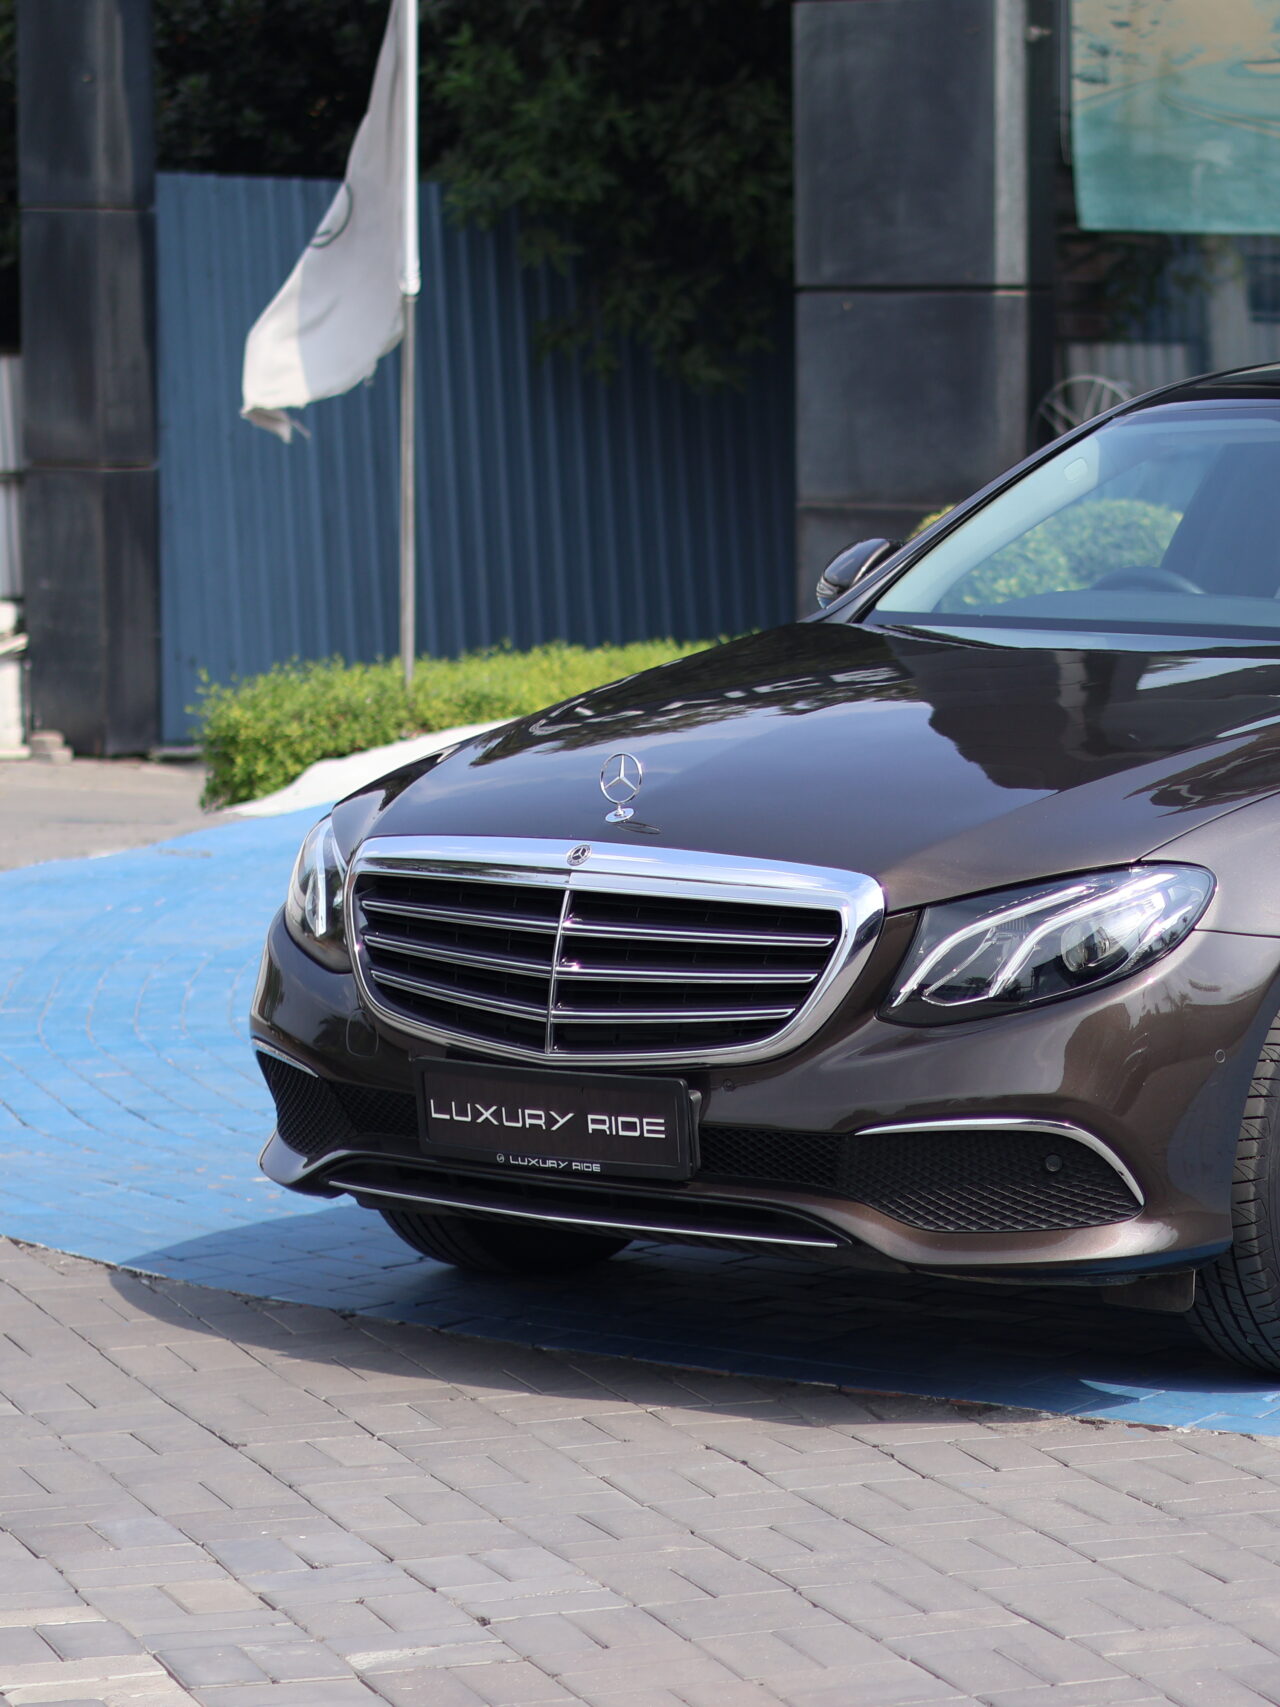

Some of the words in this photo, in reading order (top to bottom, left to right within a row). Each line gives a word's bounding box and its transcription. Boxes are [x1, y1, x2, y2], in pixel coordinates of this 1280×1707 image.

[430, 1099, 575, 1131] LUXURY
[587, 1114, 666, 1138] RIDE
[510, 1156, 568, 1169] LUXURY
[572, 1162, 601, 1172] RIDE
